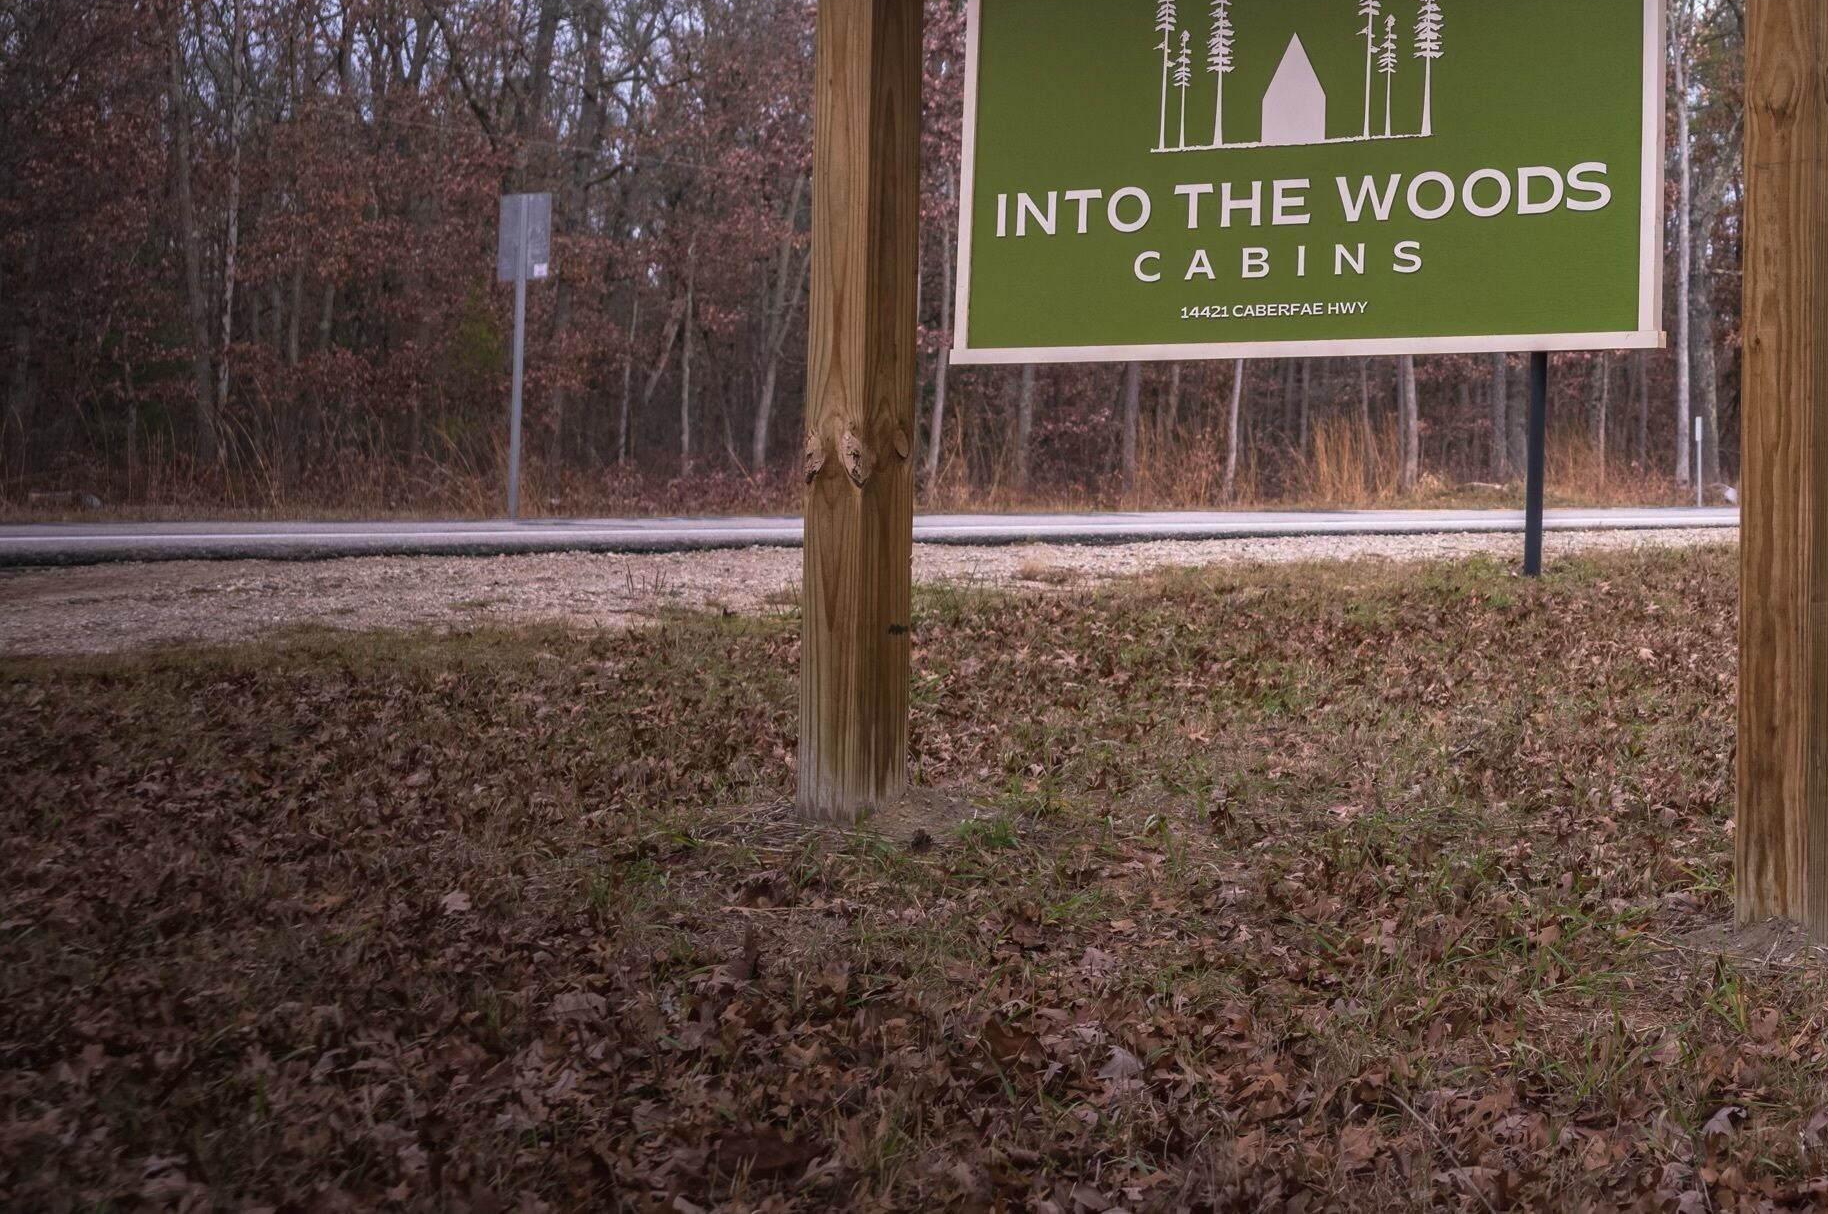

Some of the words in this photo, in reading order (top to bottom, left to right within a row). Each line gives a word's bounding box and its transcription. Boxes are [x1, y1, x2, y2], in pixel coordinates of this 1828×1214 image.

[996, 187, 1151, 237] INTO
[1174, 179, 1310, 228] THE
[1336, 162, 1611, 221] WOODS
[1134, 241, 1421, 281] CABINS
[1180, 305, 1230, 319] 14421
[1232, 302, 1324, 318] CABERFAE
[1327, 300, 1368, 315] HWY
